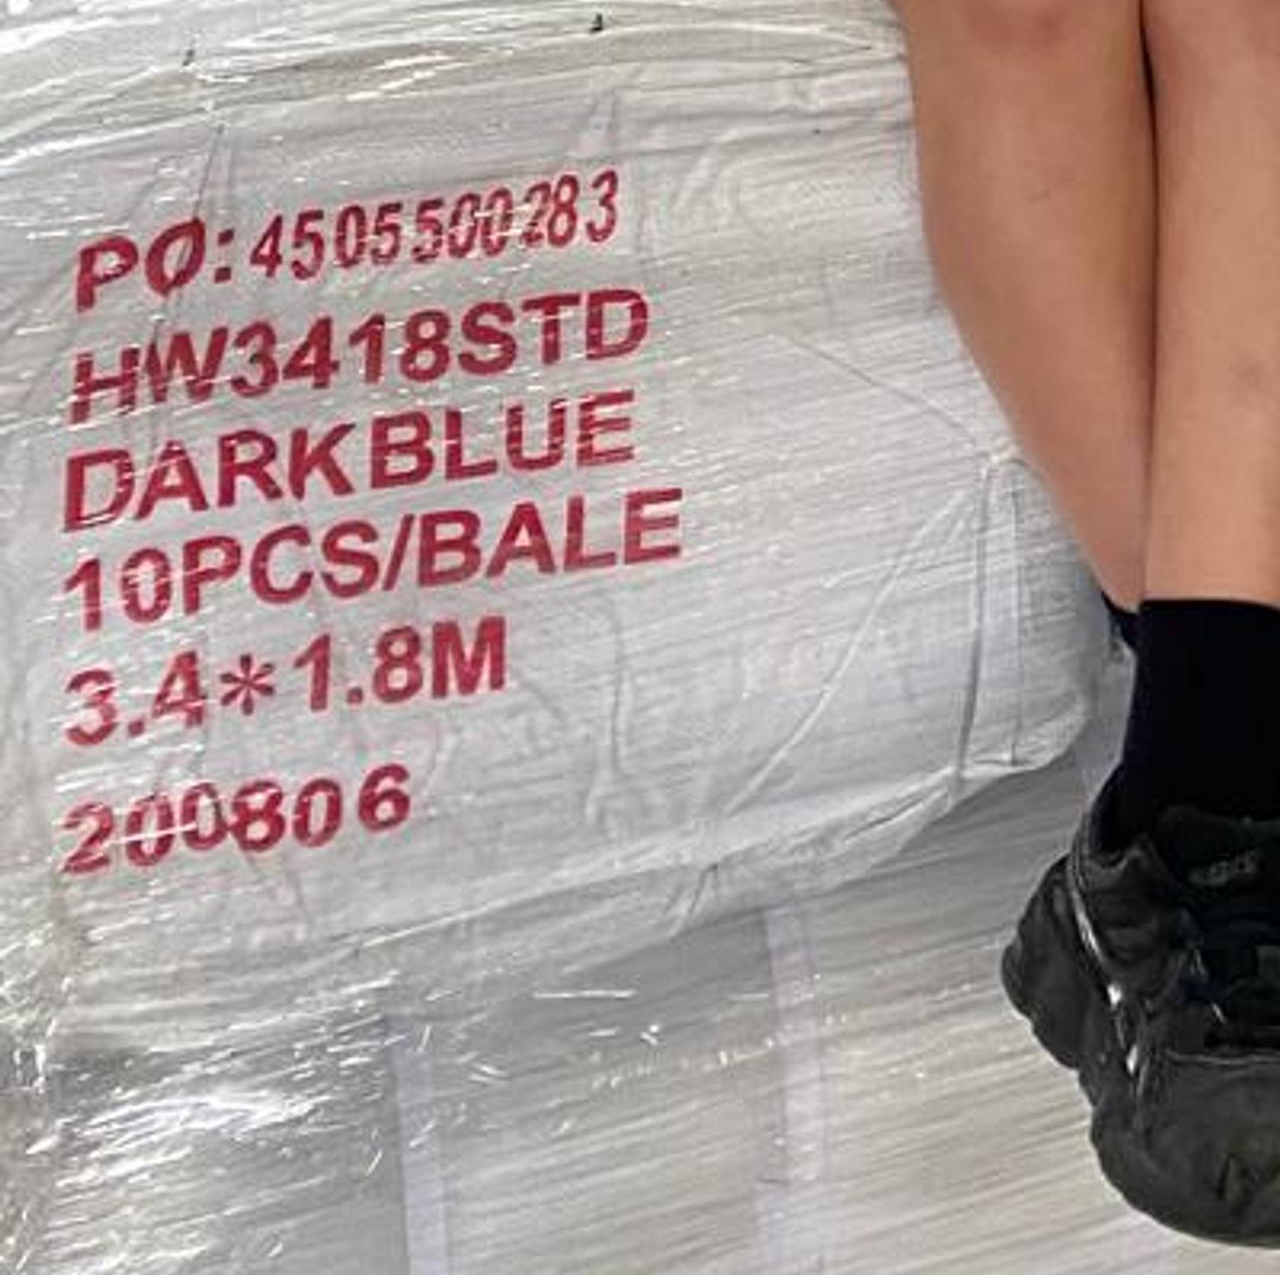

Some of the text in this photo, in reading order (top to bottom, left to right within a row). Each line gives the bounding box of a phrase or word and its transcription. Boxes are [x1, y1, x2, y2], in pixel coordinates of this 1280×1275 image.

[66, 288, 650, 426] HW3418STD
[62, 487, 684, 634] 10PCS/BALE
[60, 762, 411, 877] 200806
